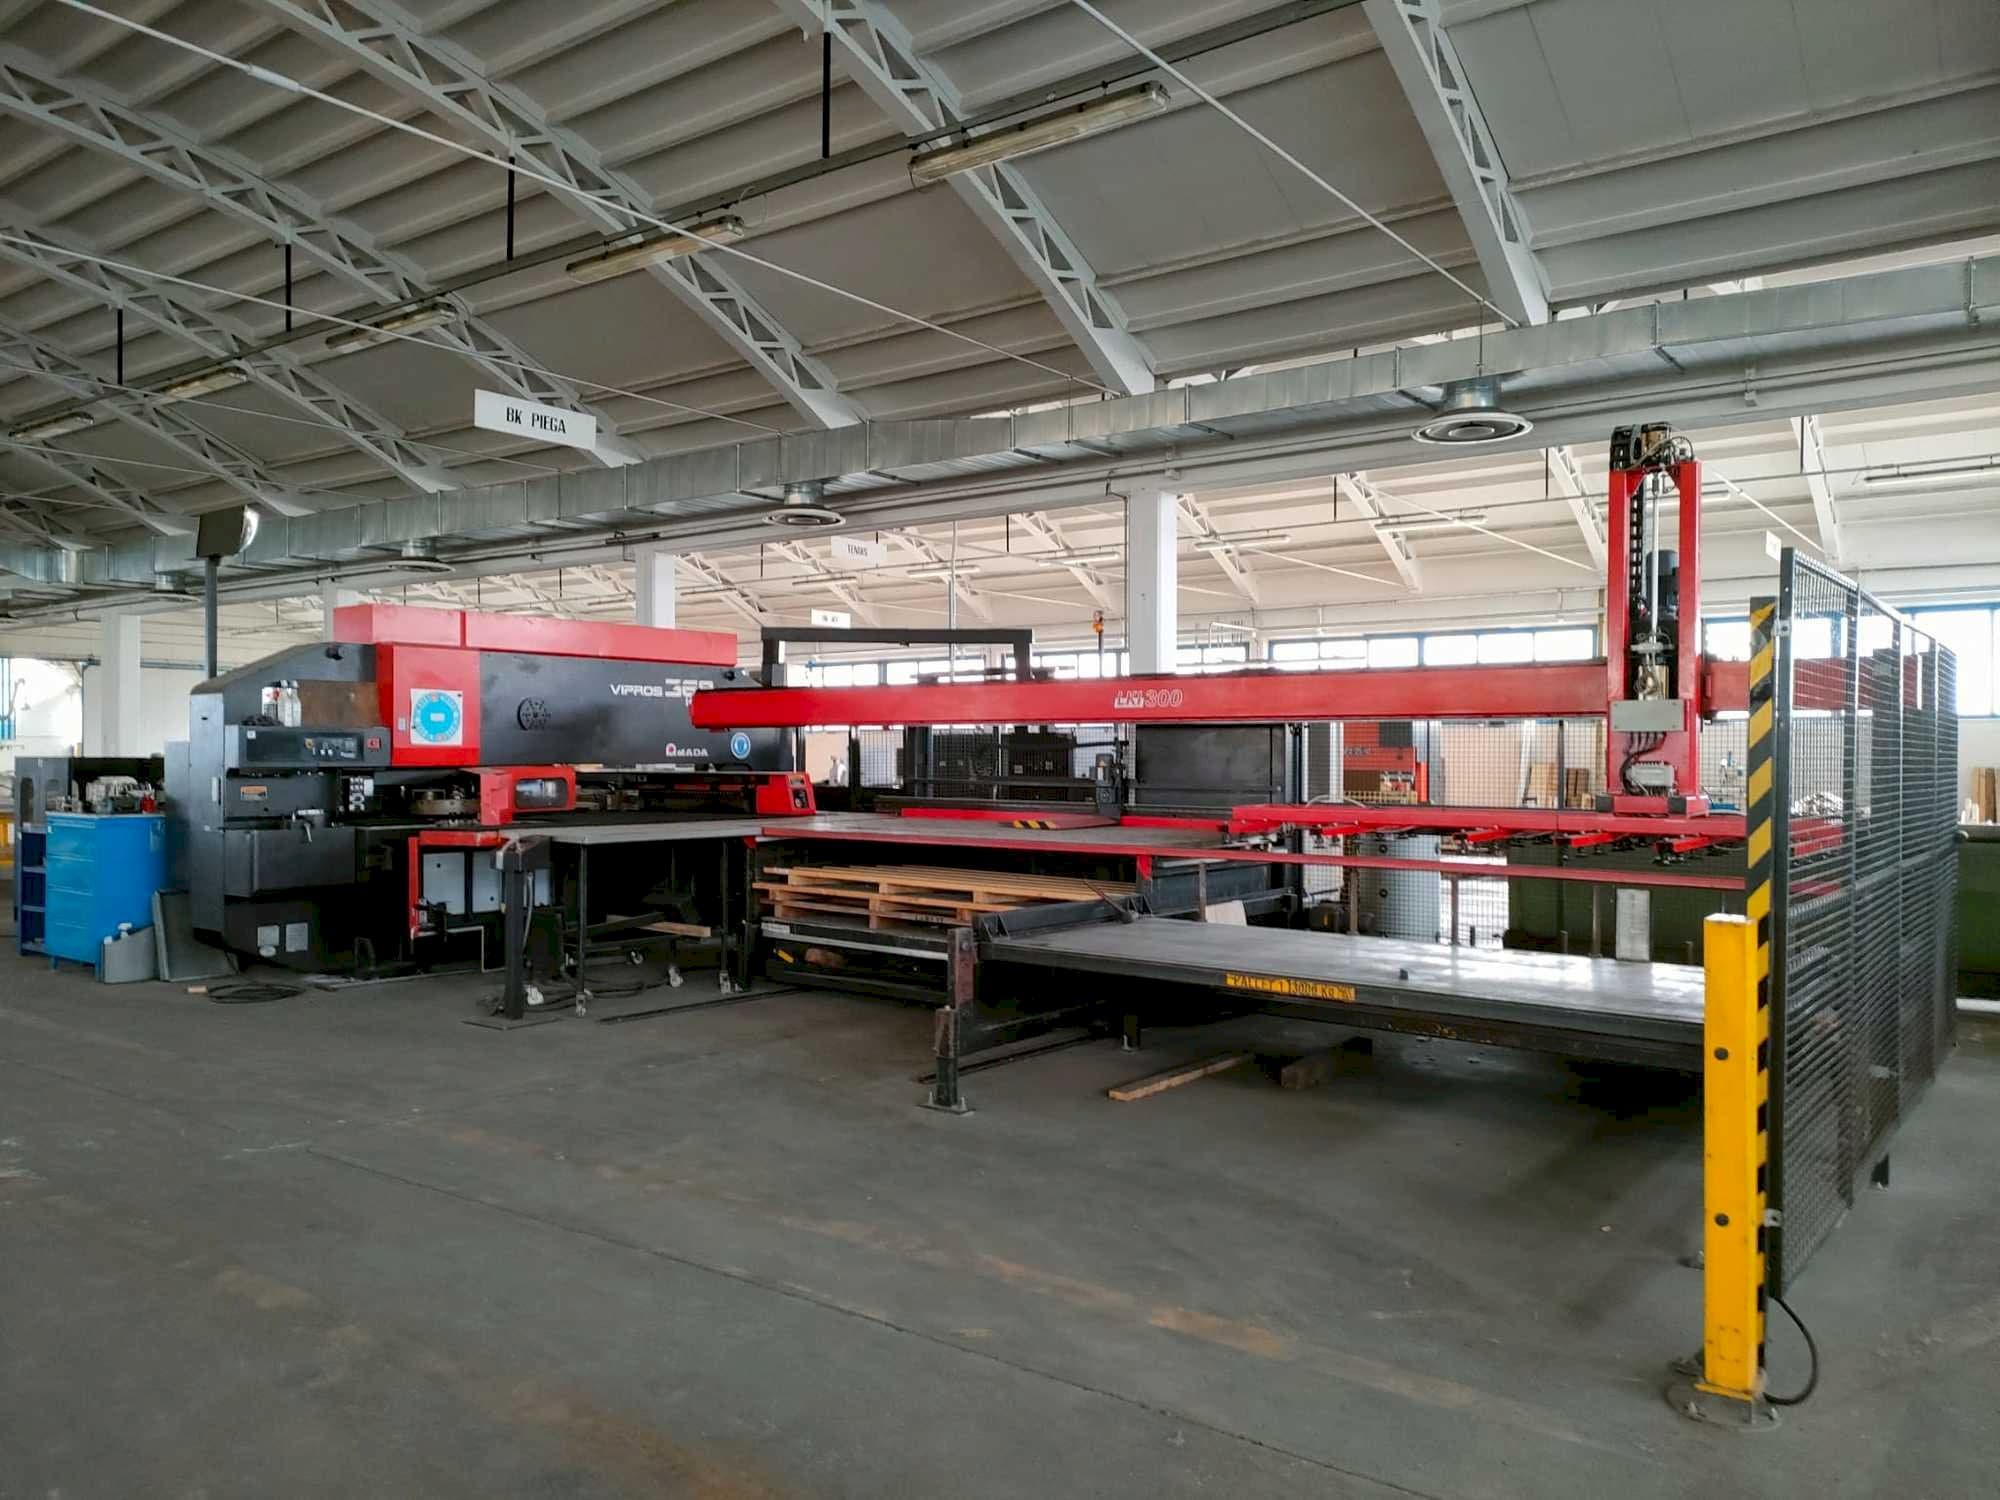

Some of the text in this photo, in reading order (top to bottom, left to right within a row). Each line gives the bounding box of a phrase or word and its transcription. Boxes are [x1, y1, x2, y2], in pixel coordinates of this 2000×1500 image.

[506, 406, 566, 434] BK PIEGA
[609, 684, 663, 697] VIPROS
